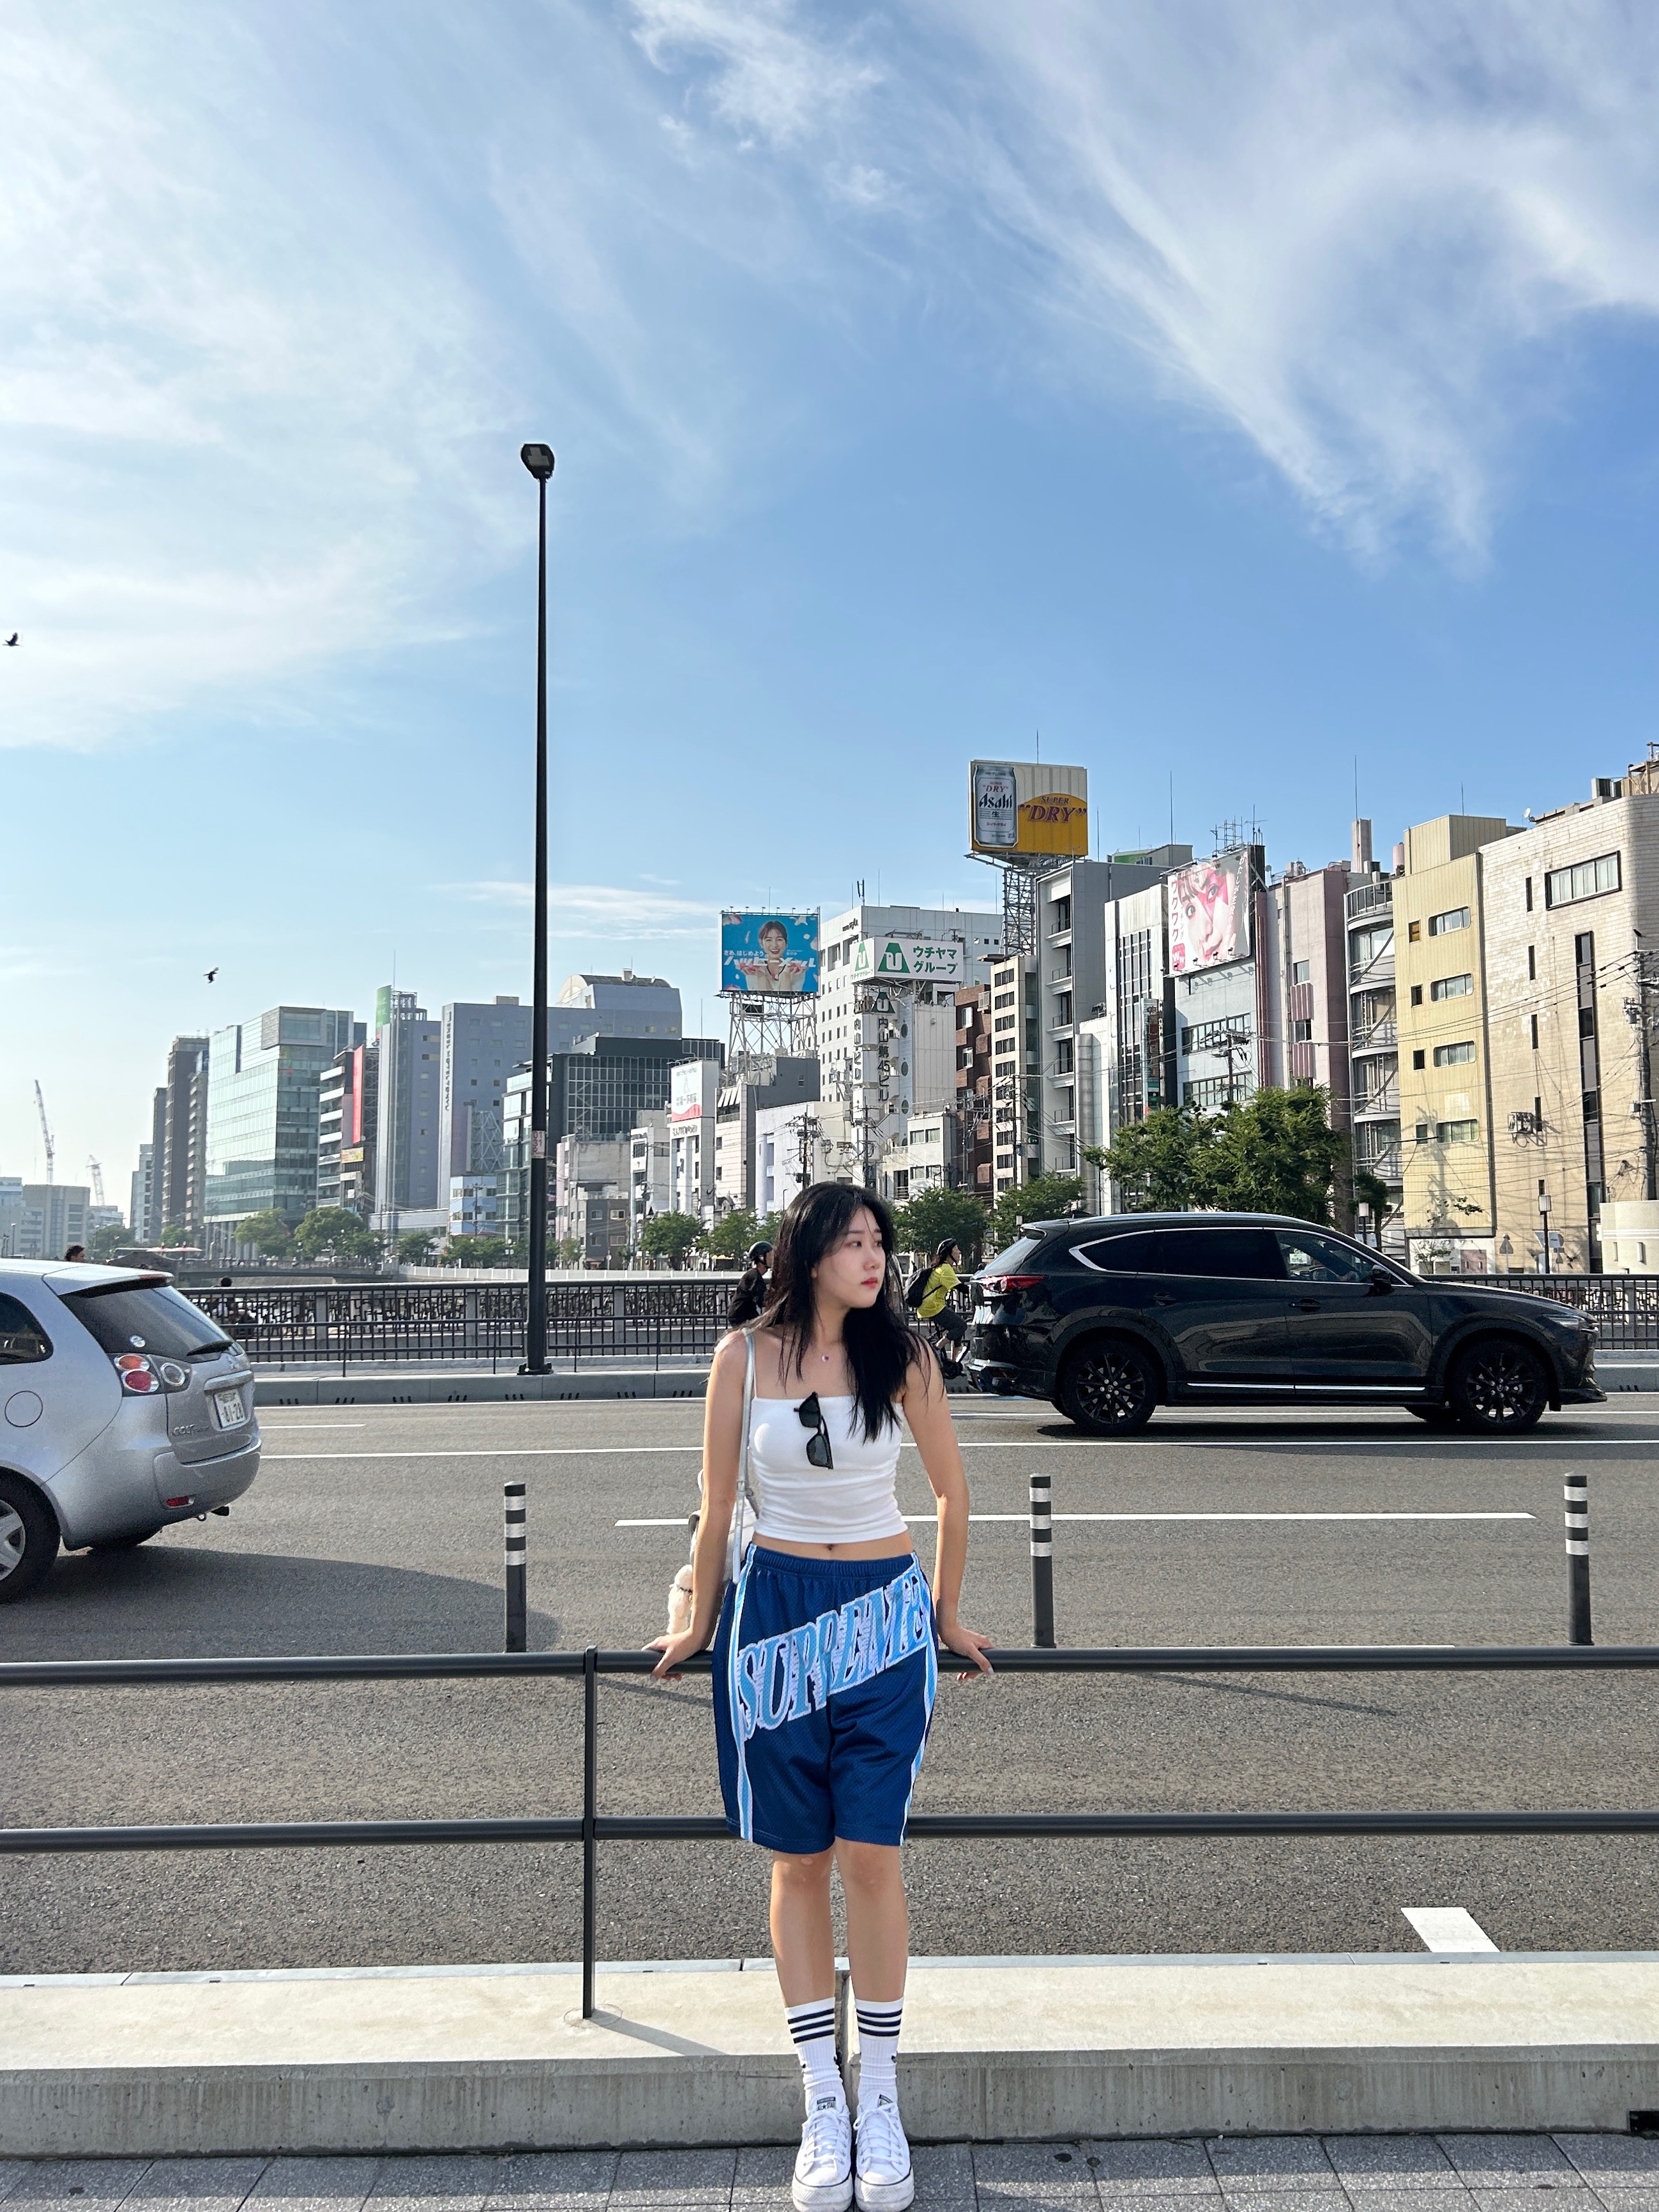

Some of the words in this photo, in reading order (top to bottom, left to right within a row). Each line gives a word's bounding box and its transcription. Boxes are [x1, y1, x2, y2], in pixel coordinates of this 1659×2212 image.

[979, 792, 1012, 809] Asahi
[1041, 796, 1069, 805] SUPER
[913, 946, 957, 960] ウチヤマ
[913, 960, 958, 974] グループ
[736, 1572, 931, 1741] SUPREME
